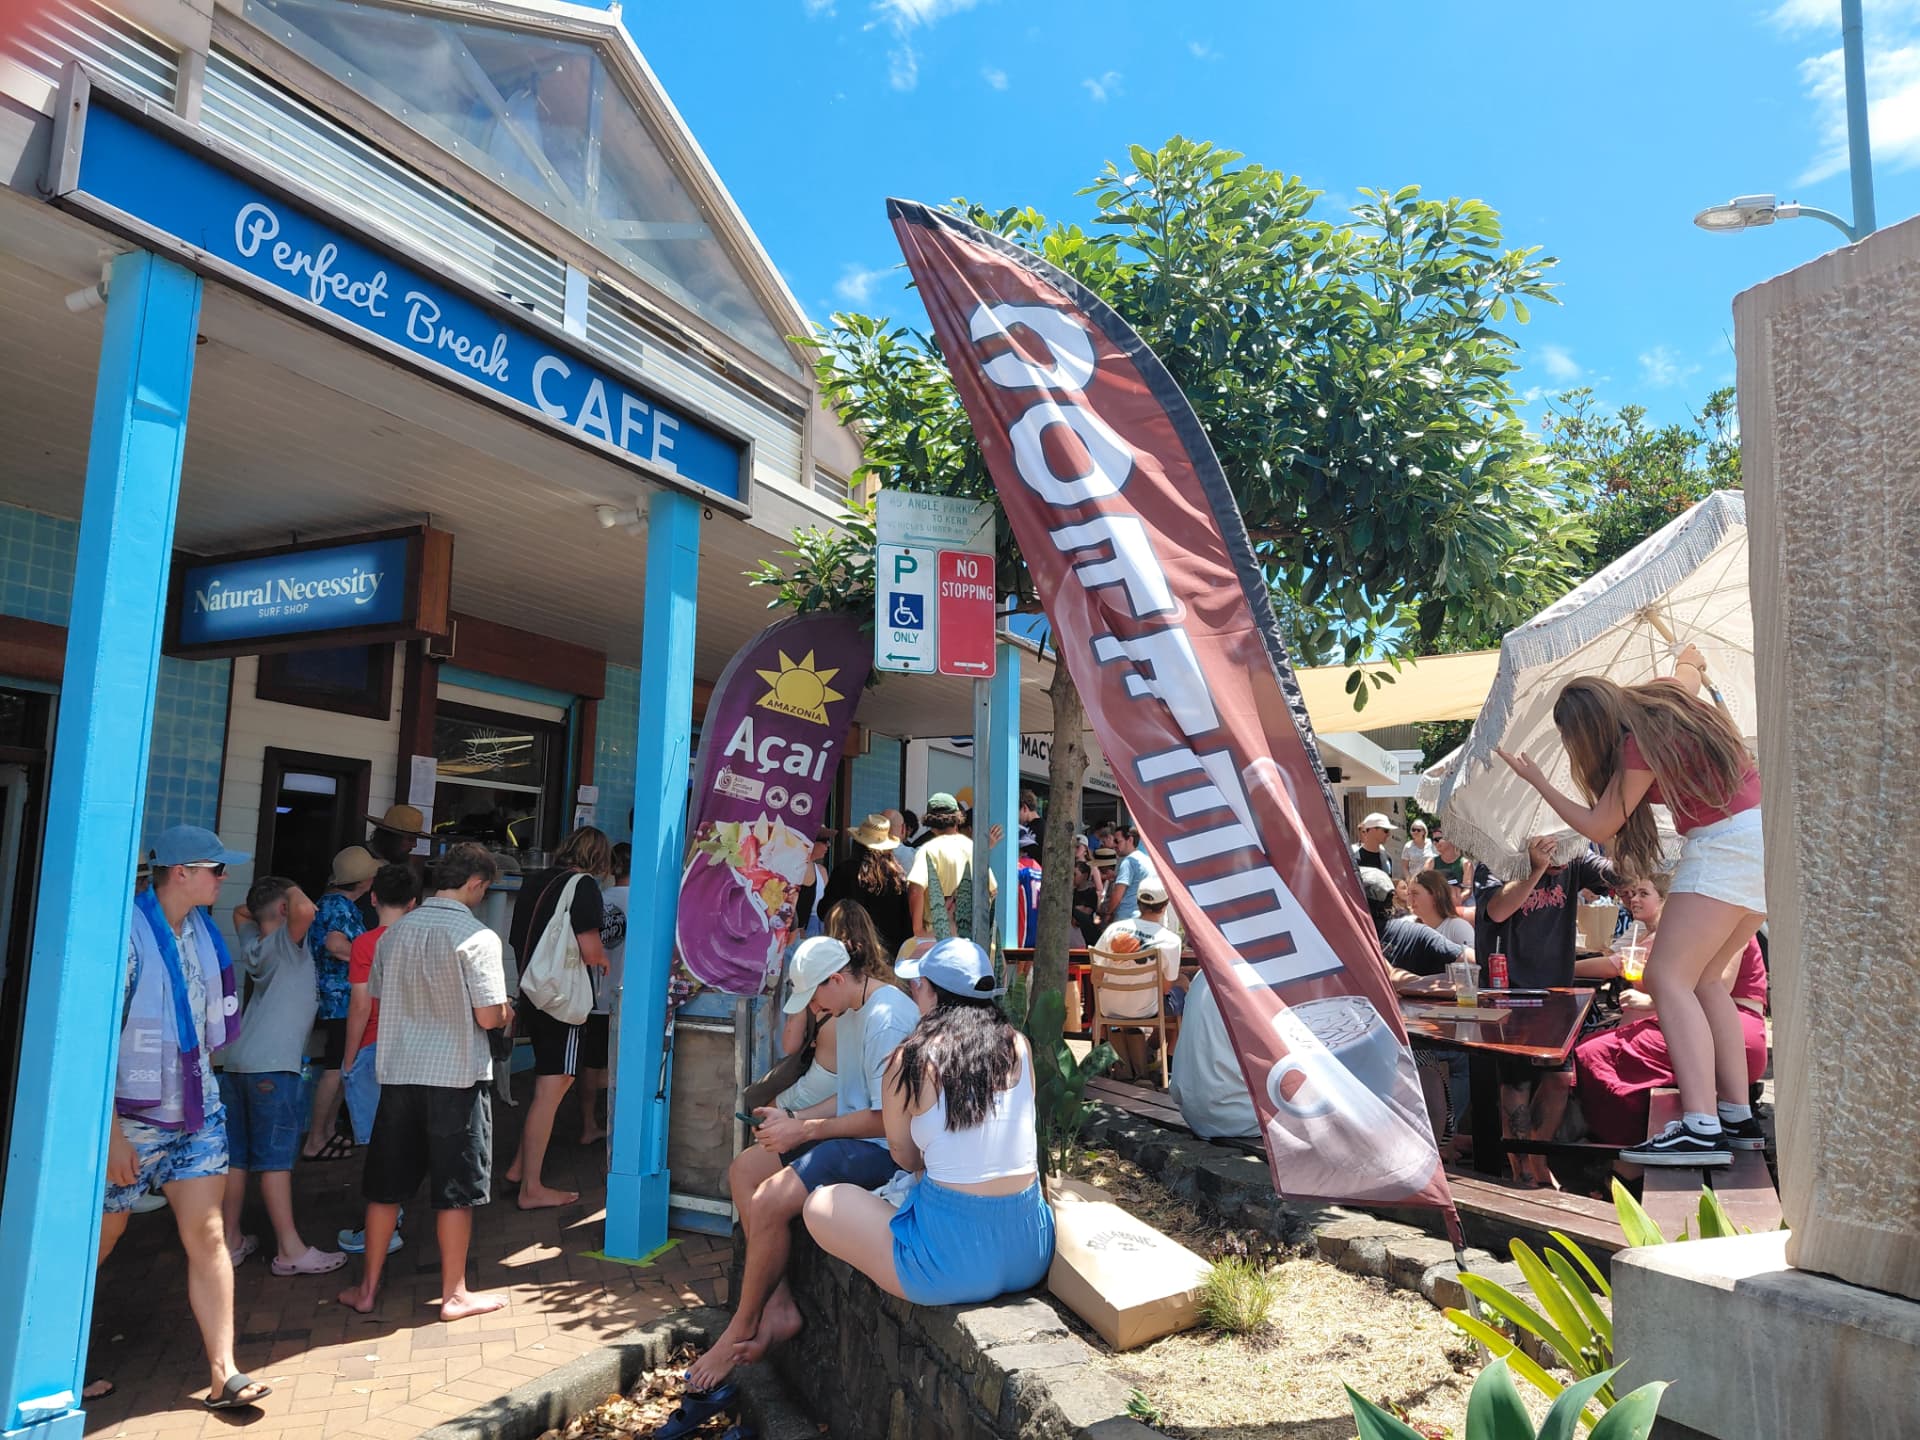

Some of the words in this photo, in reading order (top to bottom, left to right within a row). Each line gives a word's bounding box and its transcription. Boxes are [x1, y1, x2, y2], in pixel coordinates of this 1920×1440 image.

[234, 202, 389, 318] Perfect
[404, 290, 510, 382] Break
[532, 355, 680, 474] CAFE
[908, 497, 939, 512] ANGLE
[932, 514, 943, 523] TO
[894, 554, 918, 584] P
[956, 559, 979, 579] NO
[193, 580, 273, 613] Natural
[277, 567, 385, 605] Necessity
[941, 581, 993, 601] STOPPING
[258, 607, 281, 618] SURF
[284, 603, 309, 614] SHOP
[893, 631, 919, 644] ONLY
[766, 699, 822, 721] AMAZONIA
[723, 715, 834, 782] Açaí
[1020, 734, 1054, 761] MACY
